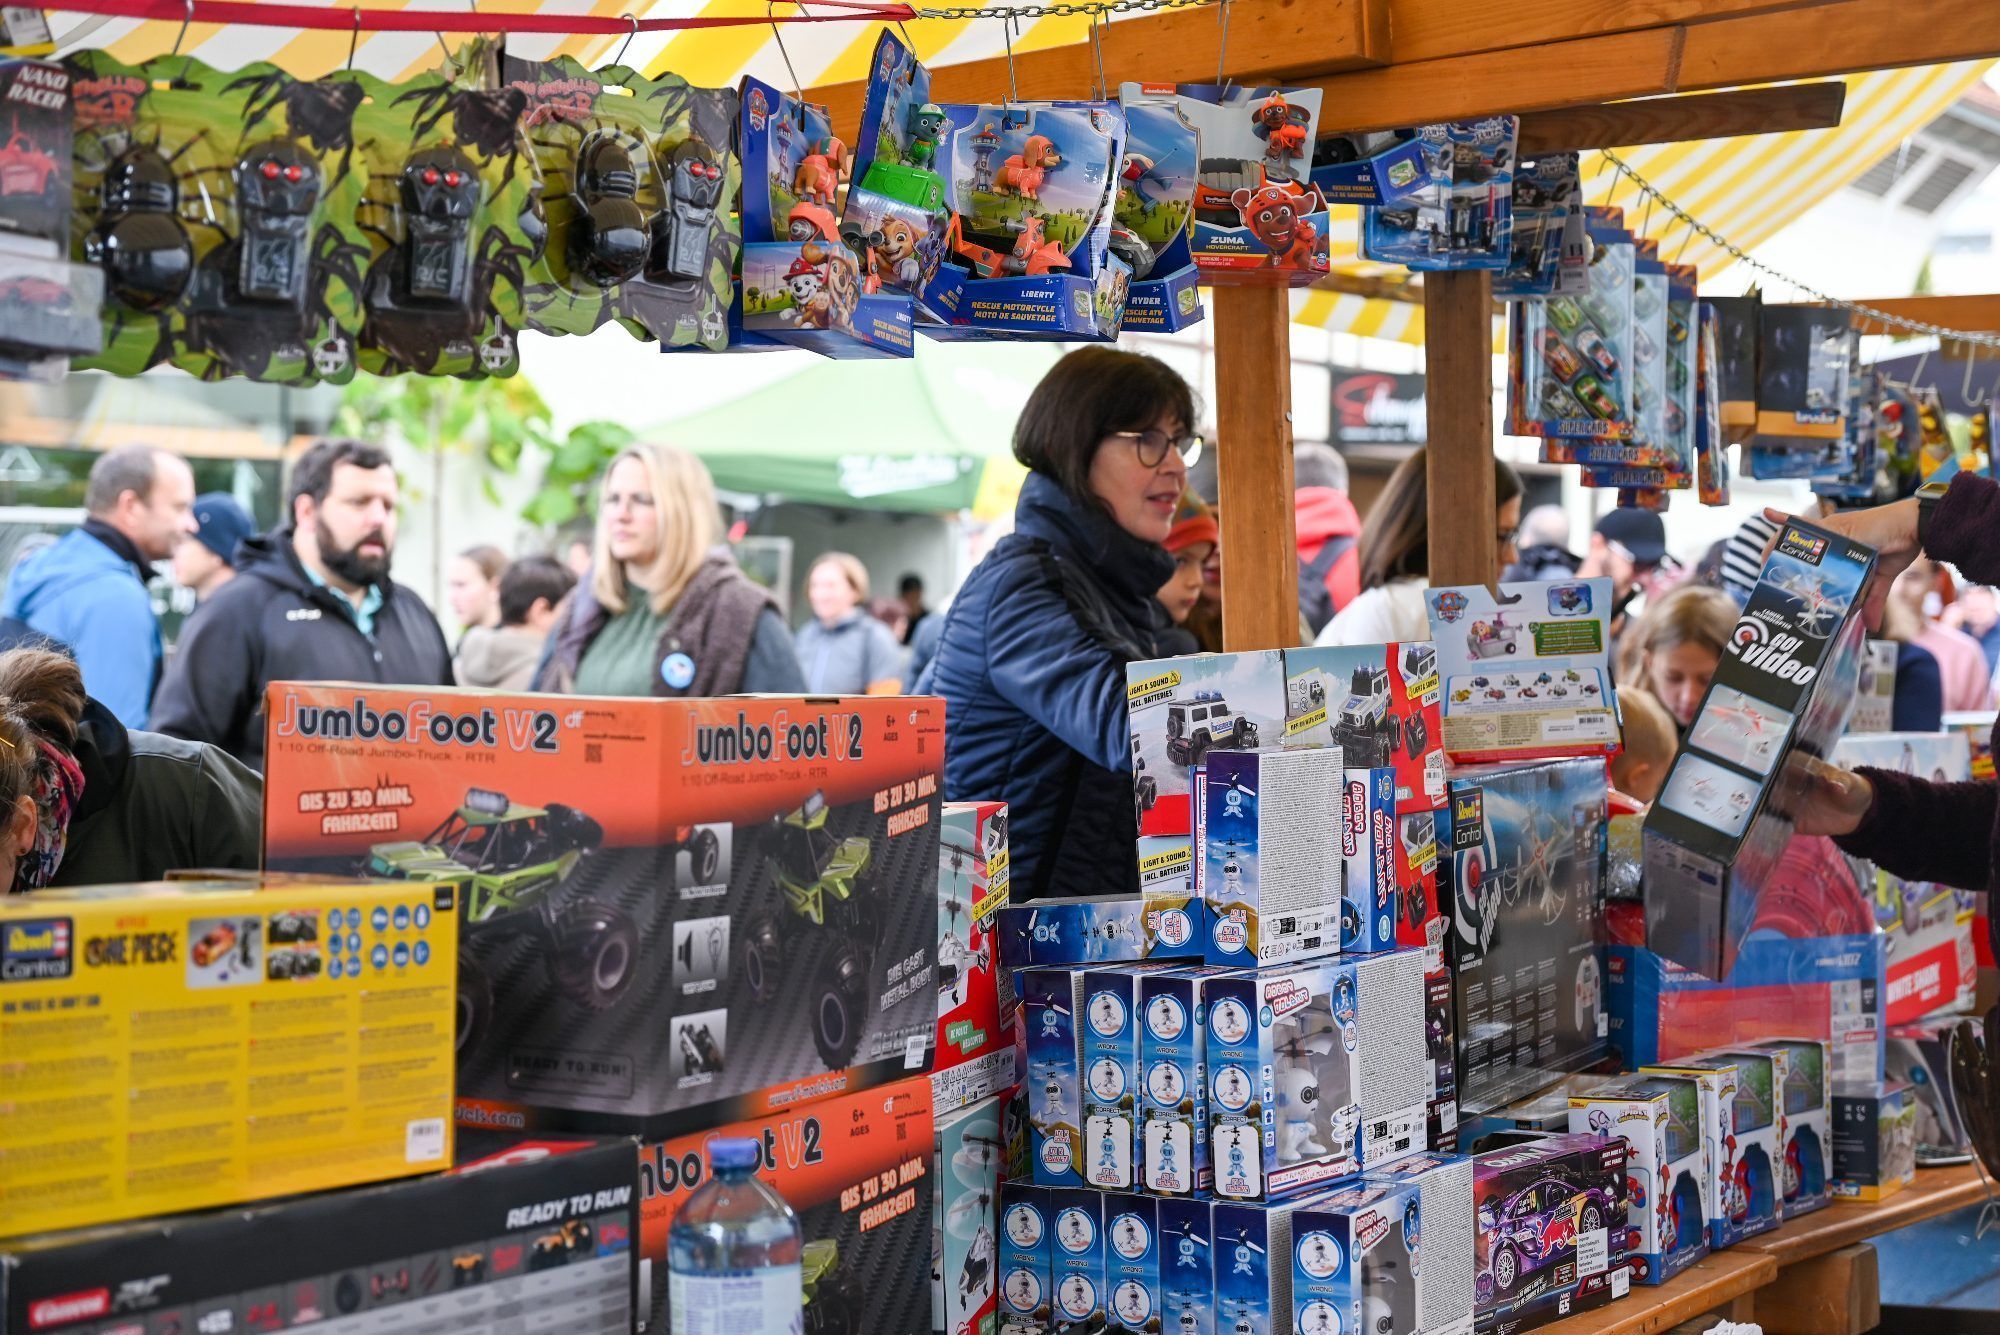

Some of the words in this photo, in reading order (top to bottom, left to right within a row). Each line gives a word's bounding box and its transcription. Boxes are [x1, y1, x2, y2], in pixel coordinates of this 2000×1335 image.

[17, 65, 69, 91] NANO
[7, 82, 67, 111] RACER
[1357, 174, 1371, 182] REX
[1210, 236, 1245, 245] ZUMA
[1021, 290, 1055, 299] LIBERTY
[1131, 296, 1161, 305] RYDER
[972, 302, 1001, 311] RESCUE
[1003, 303, 1056, 313] MOTORCYCLE
[974, 311, 998, 320] MOTO
[999, 312, 1009, 320] DE
[1010, 313, 1057, 323] SAUVETAGE
[1558, 421, 1585, 434] SUPER
[1587, 421, 1609, 434] CARS
[1589, 448, 1616, 461] SUPER
[1617, 448, 1639, 461] CARS
[1611, 472, 1639, 485] SUPER
[1788, 530, 1816, 549] Revell
[1779, 543, 1819, 564] Control
[1129, 685, 1144, 696] LIGHT
[1144, 683, 1149, 691] &
[1149, 677, 1169, 689] SOUND
[1130, 698, 1144, 709] INCL.
[1144, 689, 1173, 705] BATTERIES
[277, 693, 498, 747] JumboFoot
[504, 707, 561, 755] V2
[886, 714, 896, 728] 6+
[681, 709, 828, 766] JumboFoot
[831, 712, 863, 761] V2
[883, 731, 899, 742] AGES
[367, 747, 453, 762] Jumbo-Truck
[464, 750, 496, 764] RTR
[808, 767, 828, 780] RTR
[299, 792, 325, 812] BIS
[326, 790, 349, 809] ZU
[350, 788, 373, 808] 30
[375, 786, 414, 807] MIN.
[873, 789, 889, 815] BIS
[889, 784, 903, 809] ZU
[904, 780, 916, 804] 30
[917, 773, 937, 799] MIN.
[1457, 799, 1477, 821] Revell
[1456, 826, 1482, 845] Control
[1143, 858, 1160, 869] LIGHT
[1160, 856, 1165, 864] &
[1165, 850, 1186, 862] SOUND
[1144, 871, 1159, 882] INCL.
[1159, 864, 1190, 878] BATTERIES
[2, 959, 67, 980] Control
[887, 962, 903, 985] DIE
[902, 948, 925, 975] CAST
[880, 982, 910, 1012] METAL
[909, 965, 932, 994] BODY
[512, 1056, 559, 1070] READY
[567, 1060, 584, 1072] TO
[883, 1096, 894, 1114] df
[1095, 1106, 1120, 1114] CORRECT
[852, 1109, 865, 1123] 6+
[1154, 1110, 1180, 1118] CORRECT
[1221, 1115, 1248, 1124] CORRECT
[850, 1124, 870, 1138] AGES
[781, 1116, 824, 1170] V2
[840, 1185, 861, 1213] BIS
[862, 1176, 879, 1203] ZU
[881, 1168, 897, 1195] 30
[899, 1156, 926, 1185] MIN.
[506, 1200, 567, 1229] READY
[570, 1194, 593, 1216] TO
[594, 1185, 632, 1209] RUN
[1013, 1254, 1035, 1262] WRONG
[1066, 1259, 1088, 1267] WRONG
[1121, 1266, 1144, 1274] WRONG
